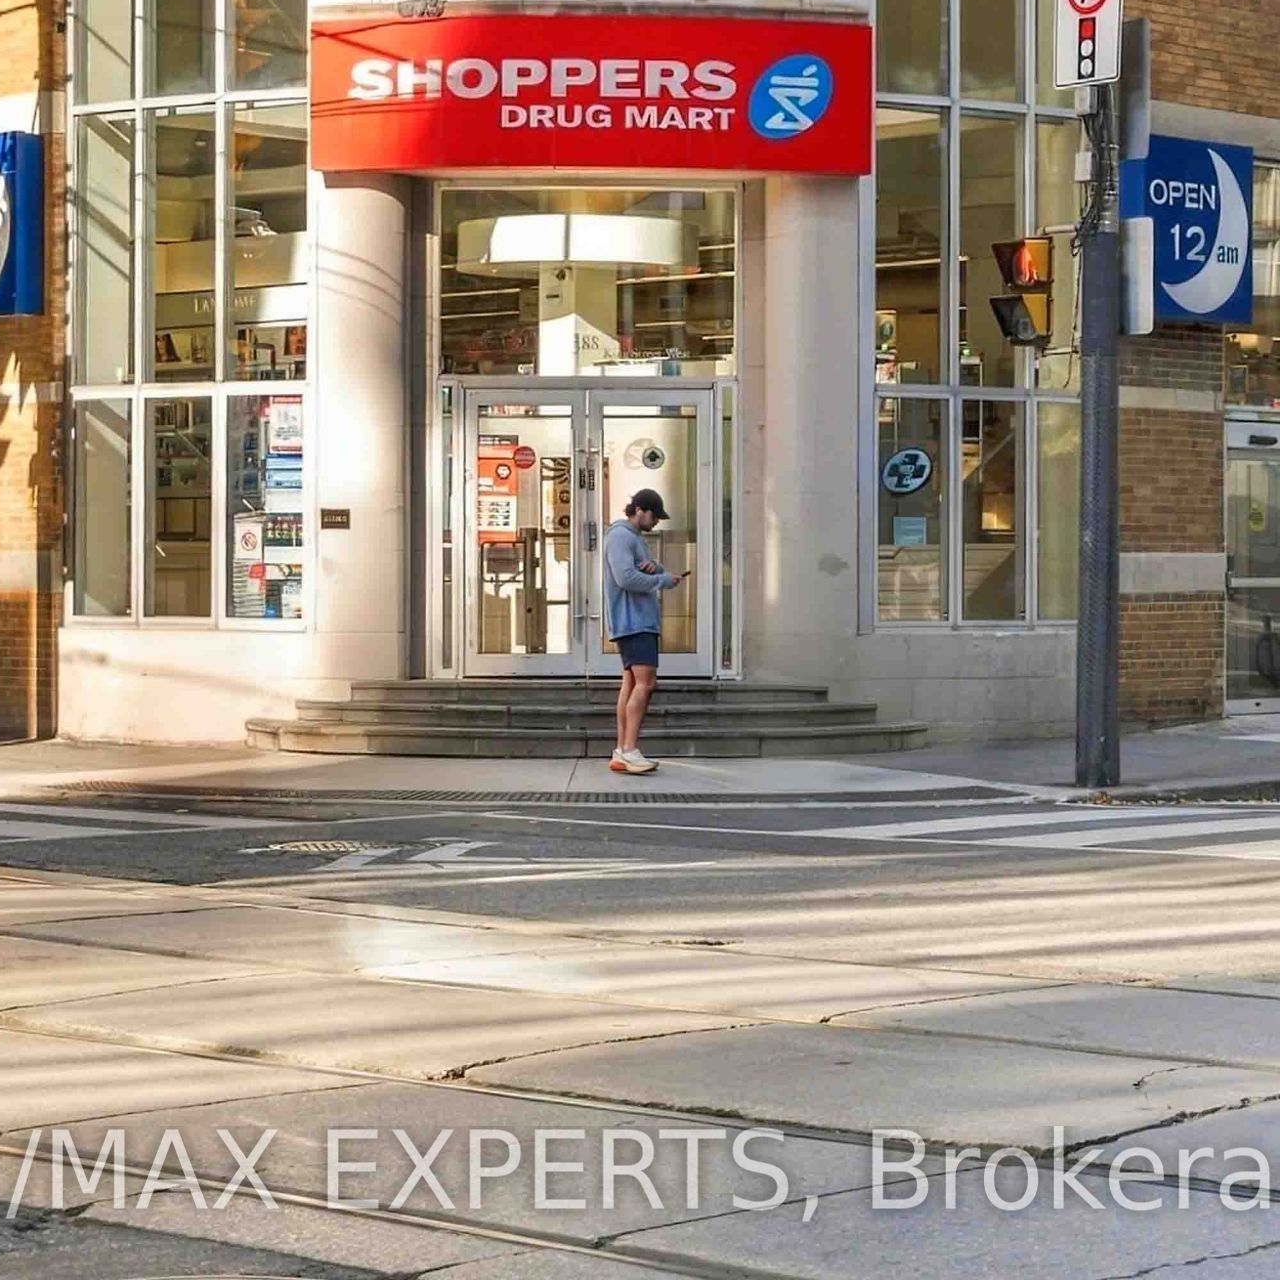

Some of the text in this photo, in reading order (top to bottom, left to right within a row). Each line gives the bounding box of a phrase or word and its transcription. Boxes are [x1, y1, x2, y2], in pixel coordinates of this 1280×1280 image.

[347, 57, 738, 101] SHOPPERS
[500, 104, 736, 131] DRUG MART
[1149, 178, 1216, 211] OPEN
[1170, 223, 1239, 265] 12 am
[193, 296, 257, 313] LAME
